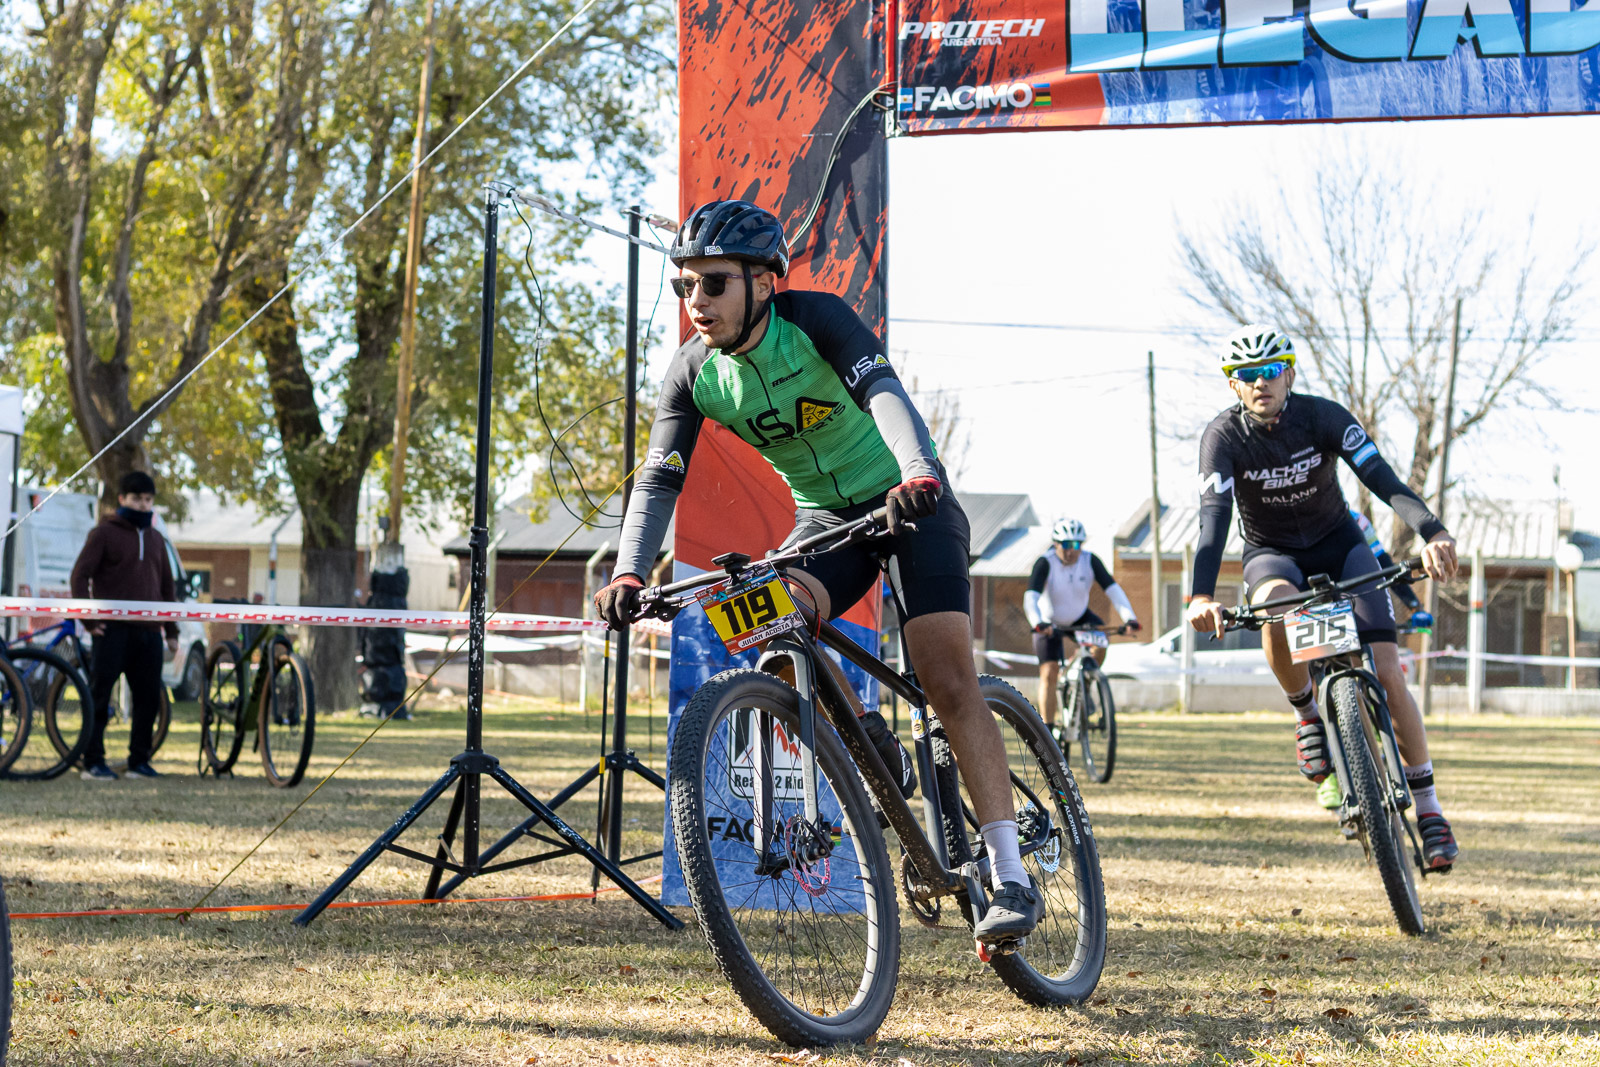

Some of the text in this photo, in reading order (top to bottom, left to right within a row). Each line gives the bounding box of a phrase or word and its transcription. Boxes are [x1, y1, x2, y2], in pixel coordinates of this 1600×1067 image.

[897, 18, 1046, 40] PROTECH
[939, 36, 1003, 47] ARGENTINA
[914, 82, 1034, 112] FACIMO
[845, 353, 891, 389] USA
[727, 396, 841, 449] USA
[1243, 453, 1322, 481] NACHOS
[1262, 471, 1310, 490] BIKE
[1261, 486, 1318, 504] BALANS
[720, 585, 778, 636] 119
[741, 634, 764, 648] JULIAN
[765, 622, 791, 639] ACOSTA
[1295, 614, 1347, 649] 215
[803, 763, 815, 808] TOSEEK
[1058, 761, 1092, 837] MAXXIS
[1063, 804, 1081, 846] ALEXRIMS
